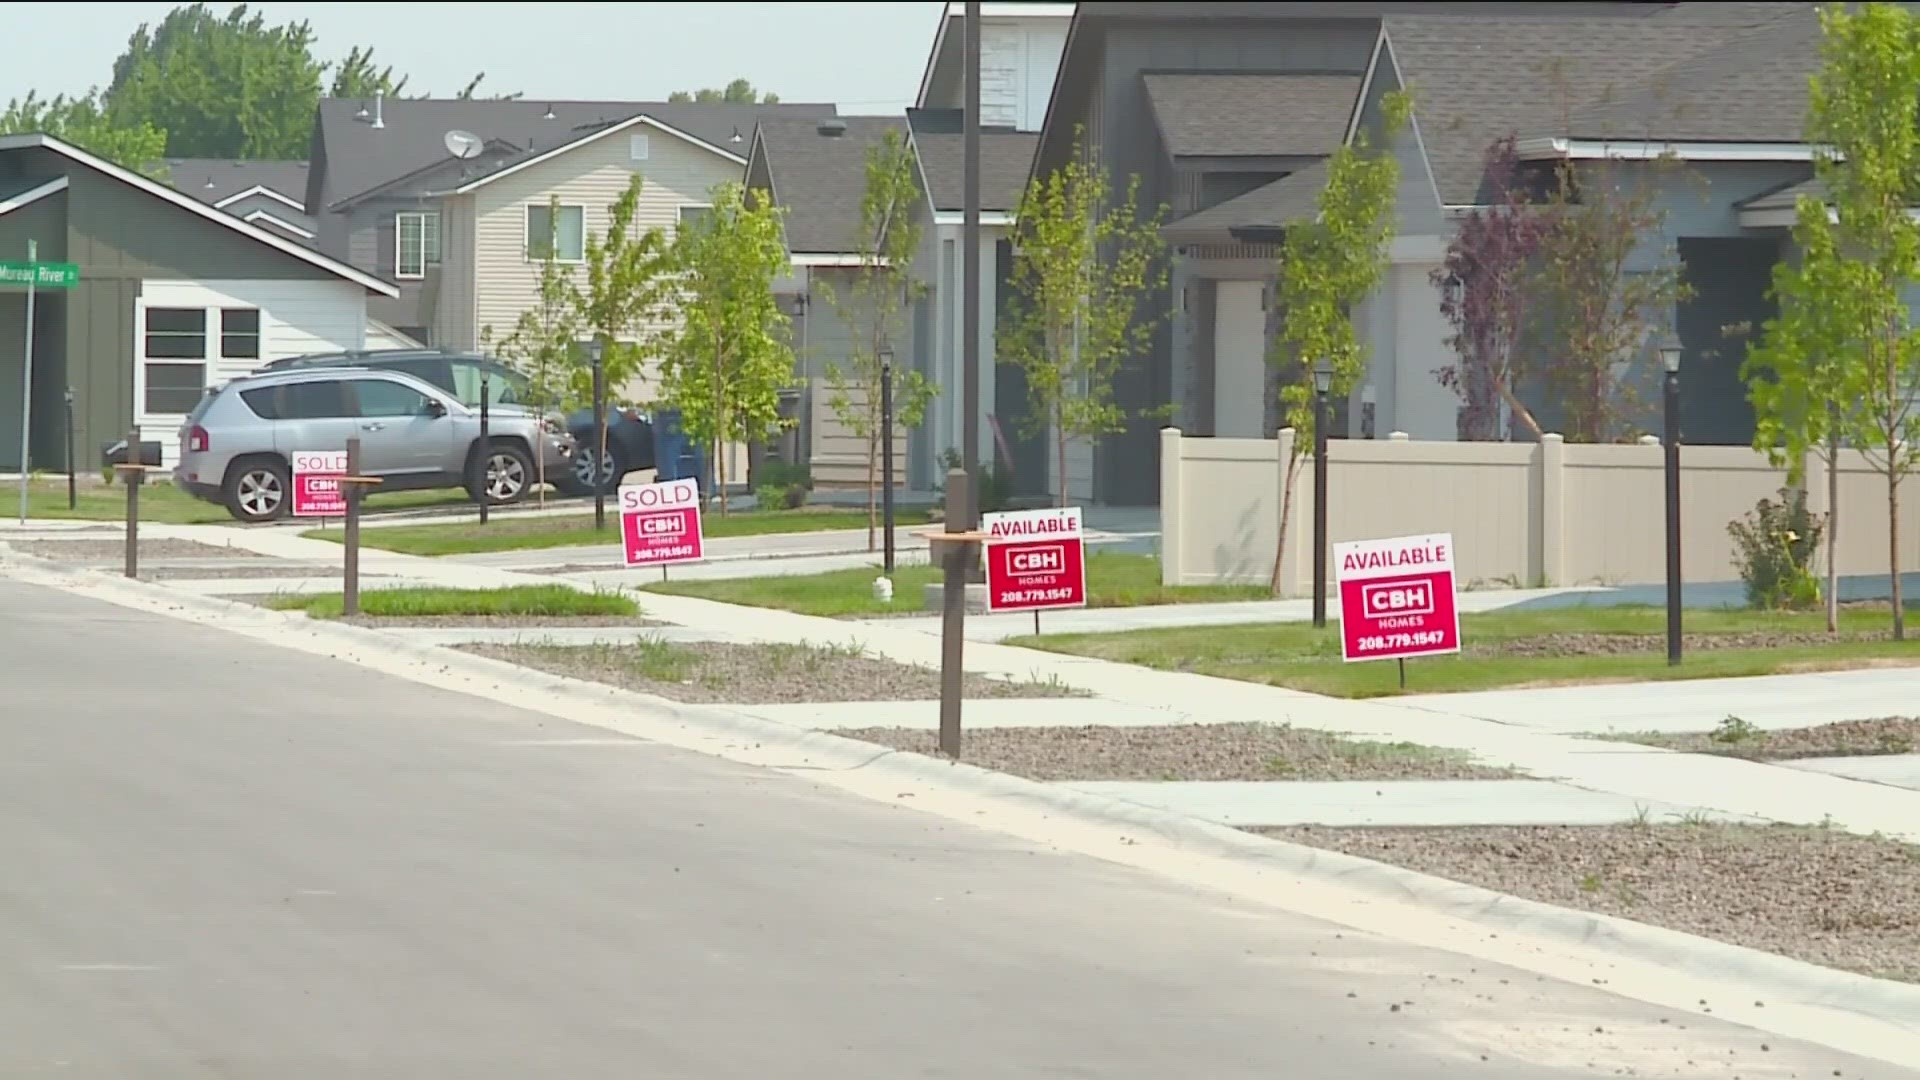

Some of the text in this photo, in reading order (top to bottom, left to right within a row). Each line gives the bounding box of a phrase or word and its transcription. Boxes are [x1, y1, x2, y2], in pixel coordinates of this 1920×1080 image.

[38, 266, 65, 282] River
[297, 457, 348, 470] SOLD
[624, 485, 692, 508] SOLD
[643, 516, 680, 533] CBH
[991, 517, 1077, 536] AVAILABLE
[1013, 552, 1058, 570] CBH
[1343, 545, 1446, 571] AVAILABLE
[1018, 575, 1057, 585] HOMES
[1001, 587, 1073, 603] 208.779.1547
[1371, 588, 1425, 610] CBH
[1378, 616, 1425, 629] HOMES
[1357, 630, 1445, 651] 208.779.1547
